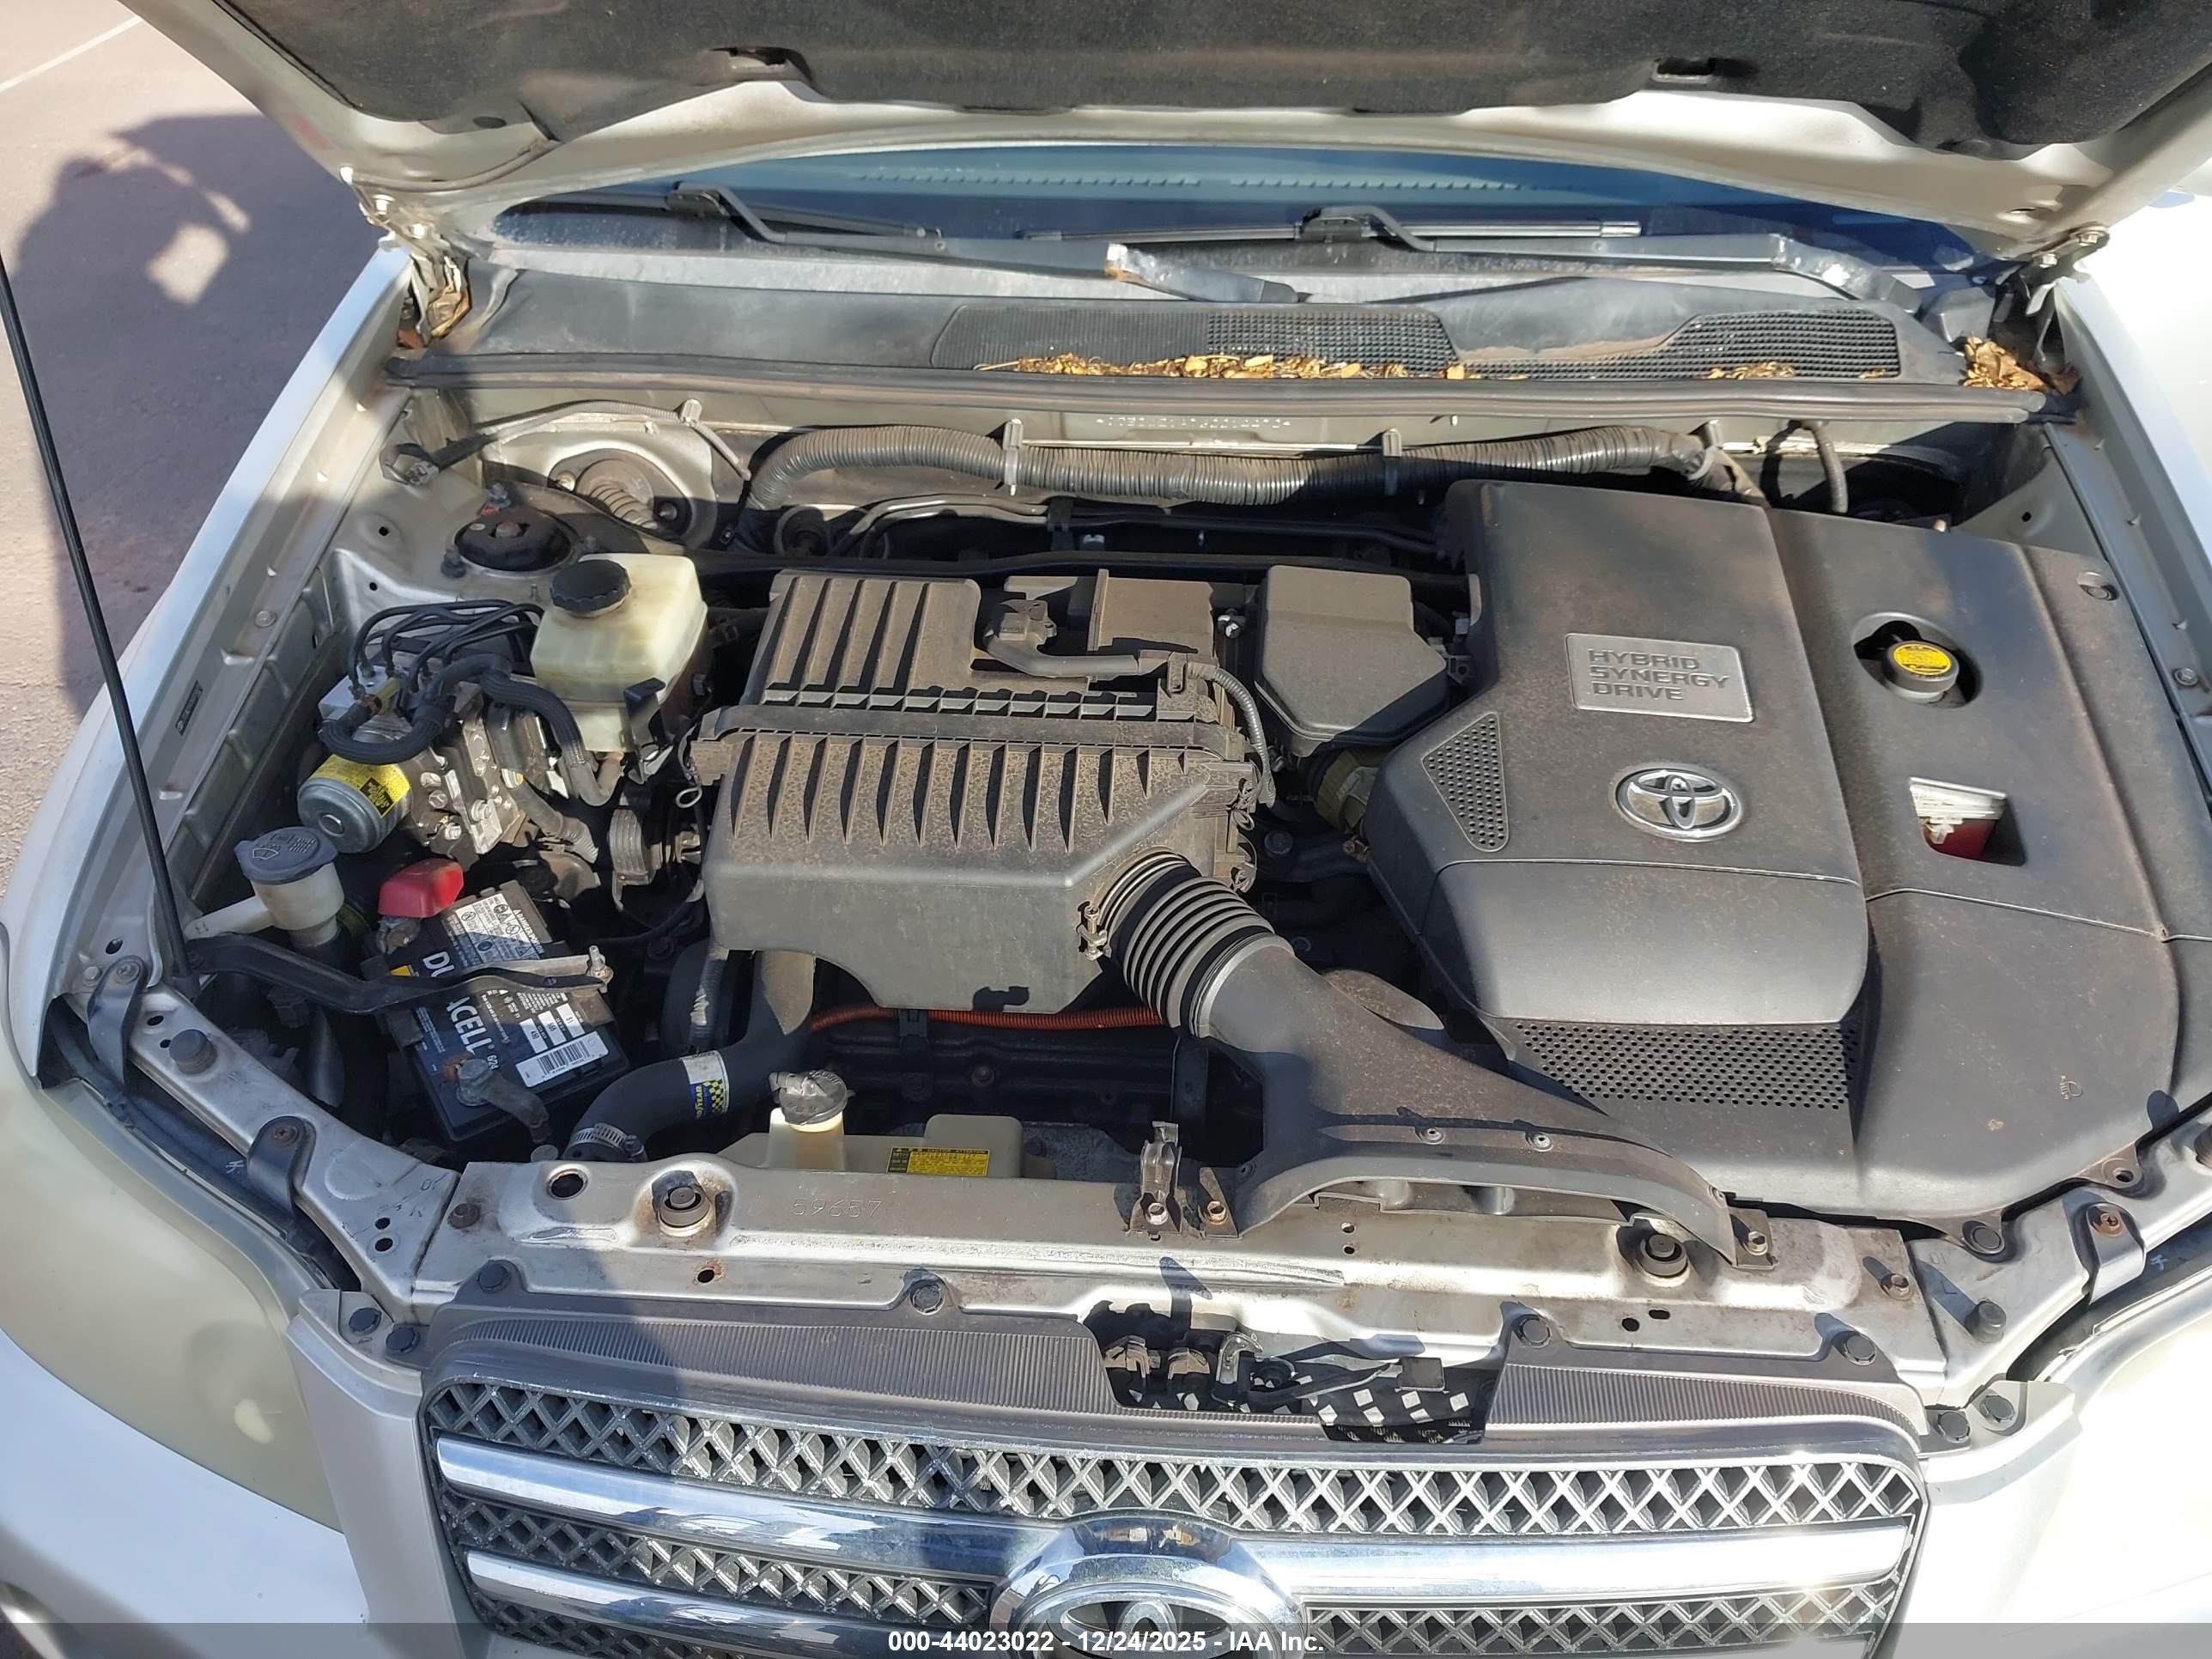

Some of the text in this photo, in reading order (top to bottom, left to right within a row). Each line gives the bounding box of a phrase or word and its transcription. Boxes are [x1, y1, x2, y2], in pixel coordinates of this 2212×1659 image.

[1587, 648, 1700, 670] HYBRID
[1589, 665, 1730, 689] SYNERGY
[1591, 681, 1684, 700] DRIVE
[792, 1198, 884, 1218] 59657
